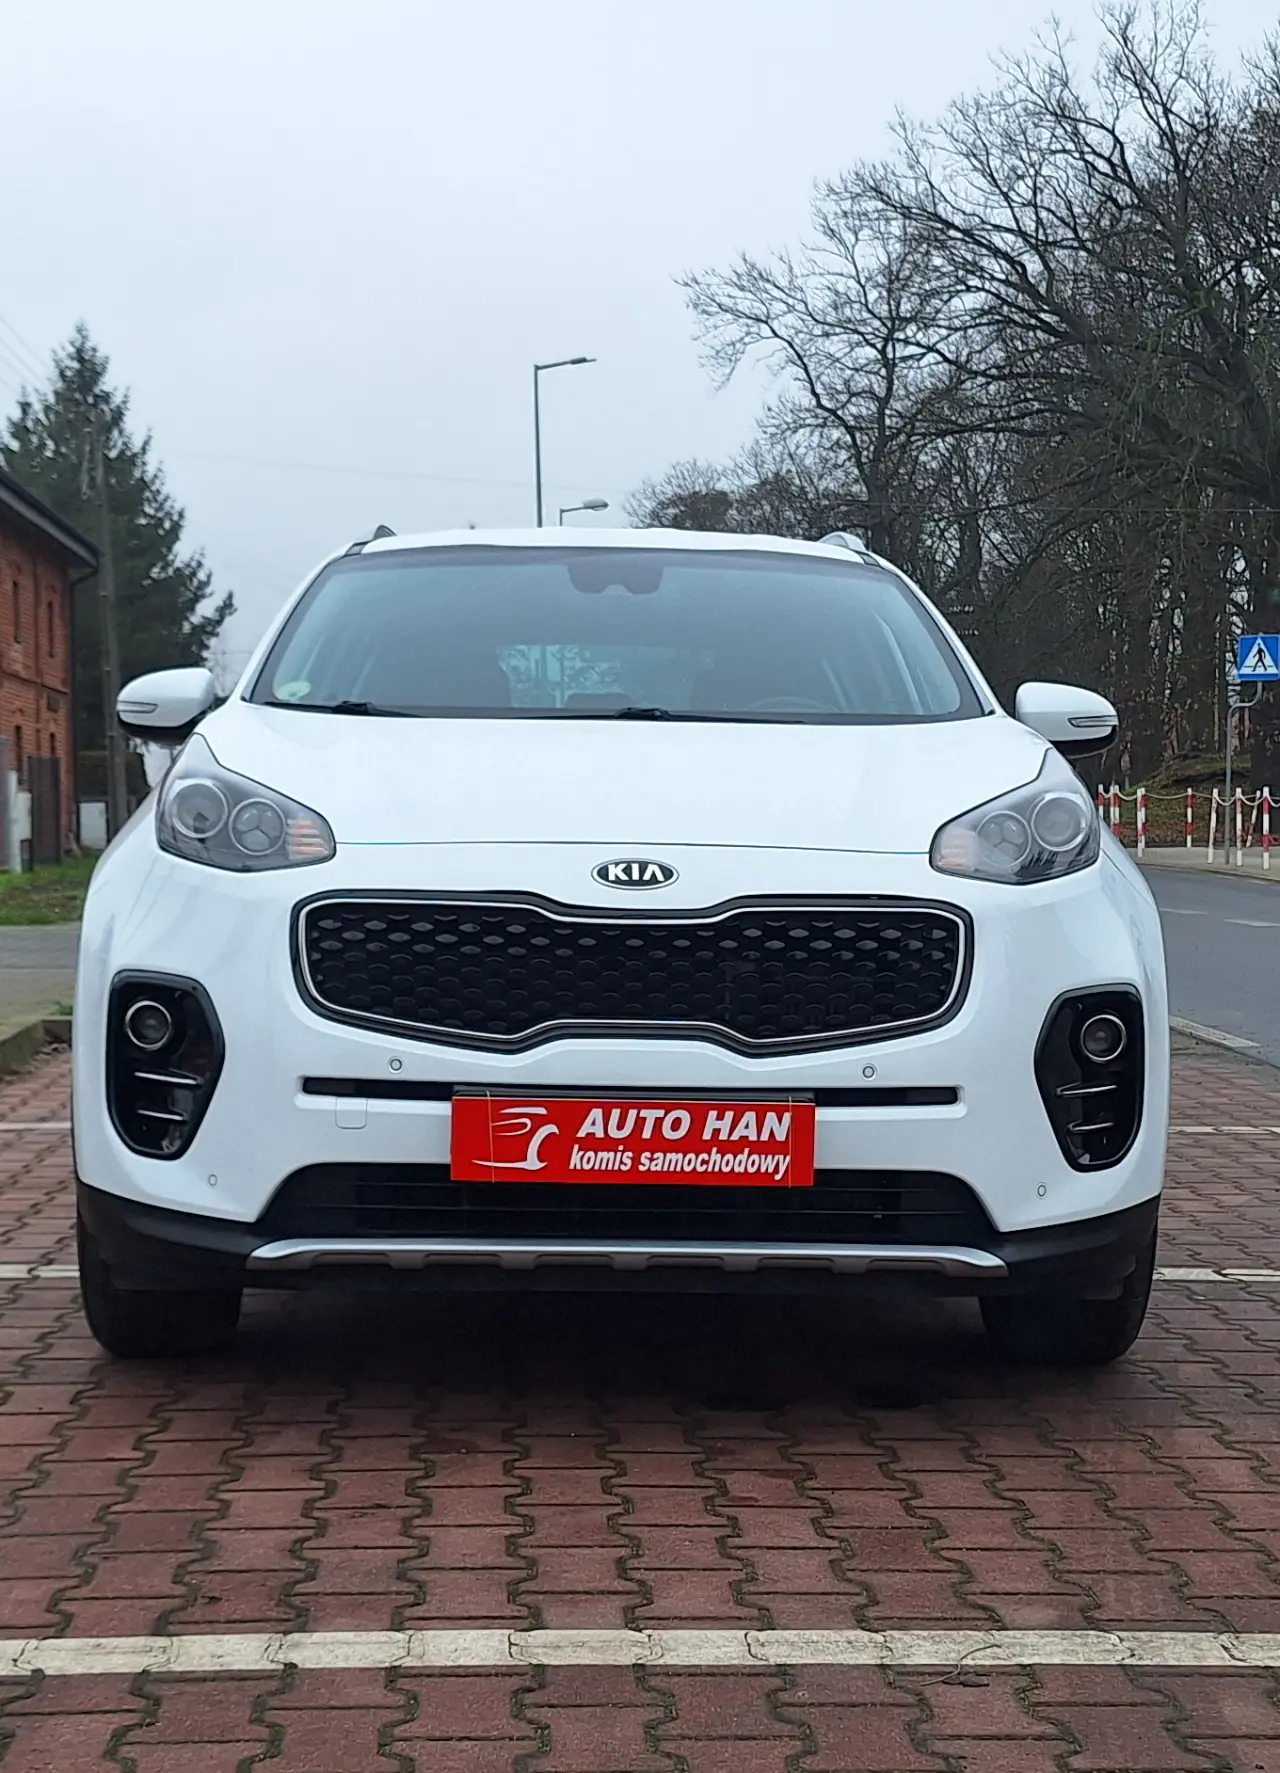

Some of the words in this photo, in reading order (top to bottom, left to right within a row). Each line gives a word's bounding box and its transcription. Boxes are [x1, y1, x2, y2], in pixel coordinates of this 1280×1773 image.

[607, 862, 666, 882] KIA
[575, 1107, 692, 1140] AUTO
[702, 1110, 792, 1142] HAN
[568, 1144, 633, 1171] komis
[637, 1146, 791, 1181] samochodowy
